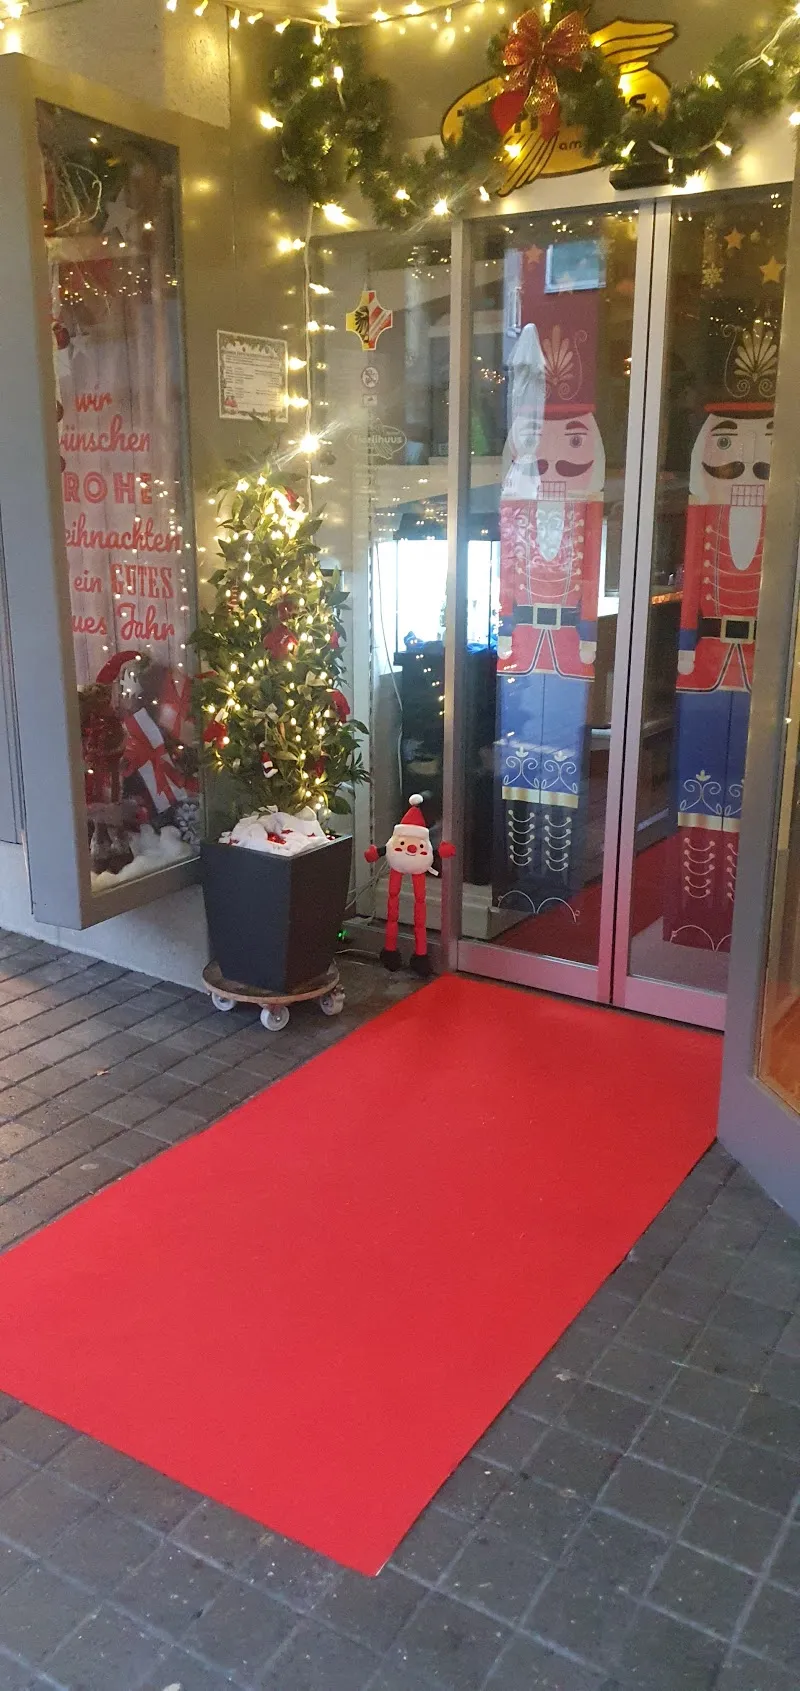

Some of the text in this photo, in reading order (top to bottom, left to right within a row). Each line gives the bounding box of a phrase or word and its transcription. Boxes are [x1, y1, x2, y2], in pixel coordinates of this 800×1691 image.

[558, 140, 582, 151] am
[75, 384, 112, 412] wir
[63, 471, 152, 504] ROHE
[65, 512, 182, 553] eihnachten
[73, 563, 174, 599] ein GUTES
[72, 602, 175, 641] ues Jahr
